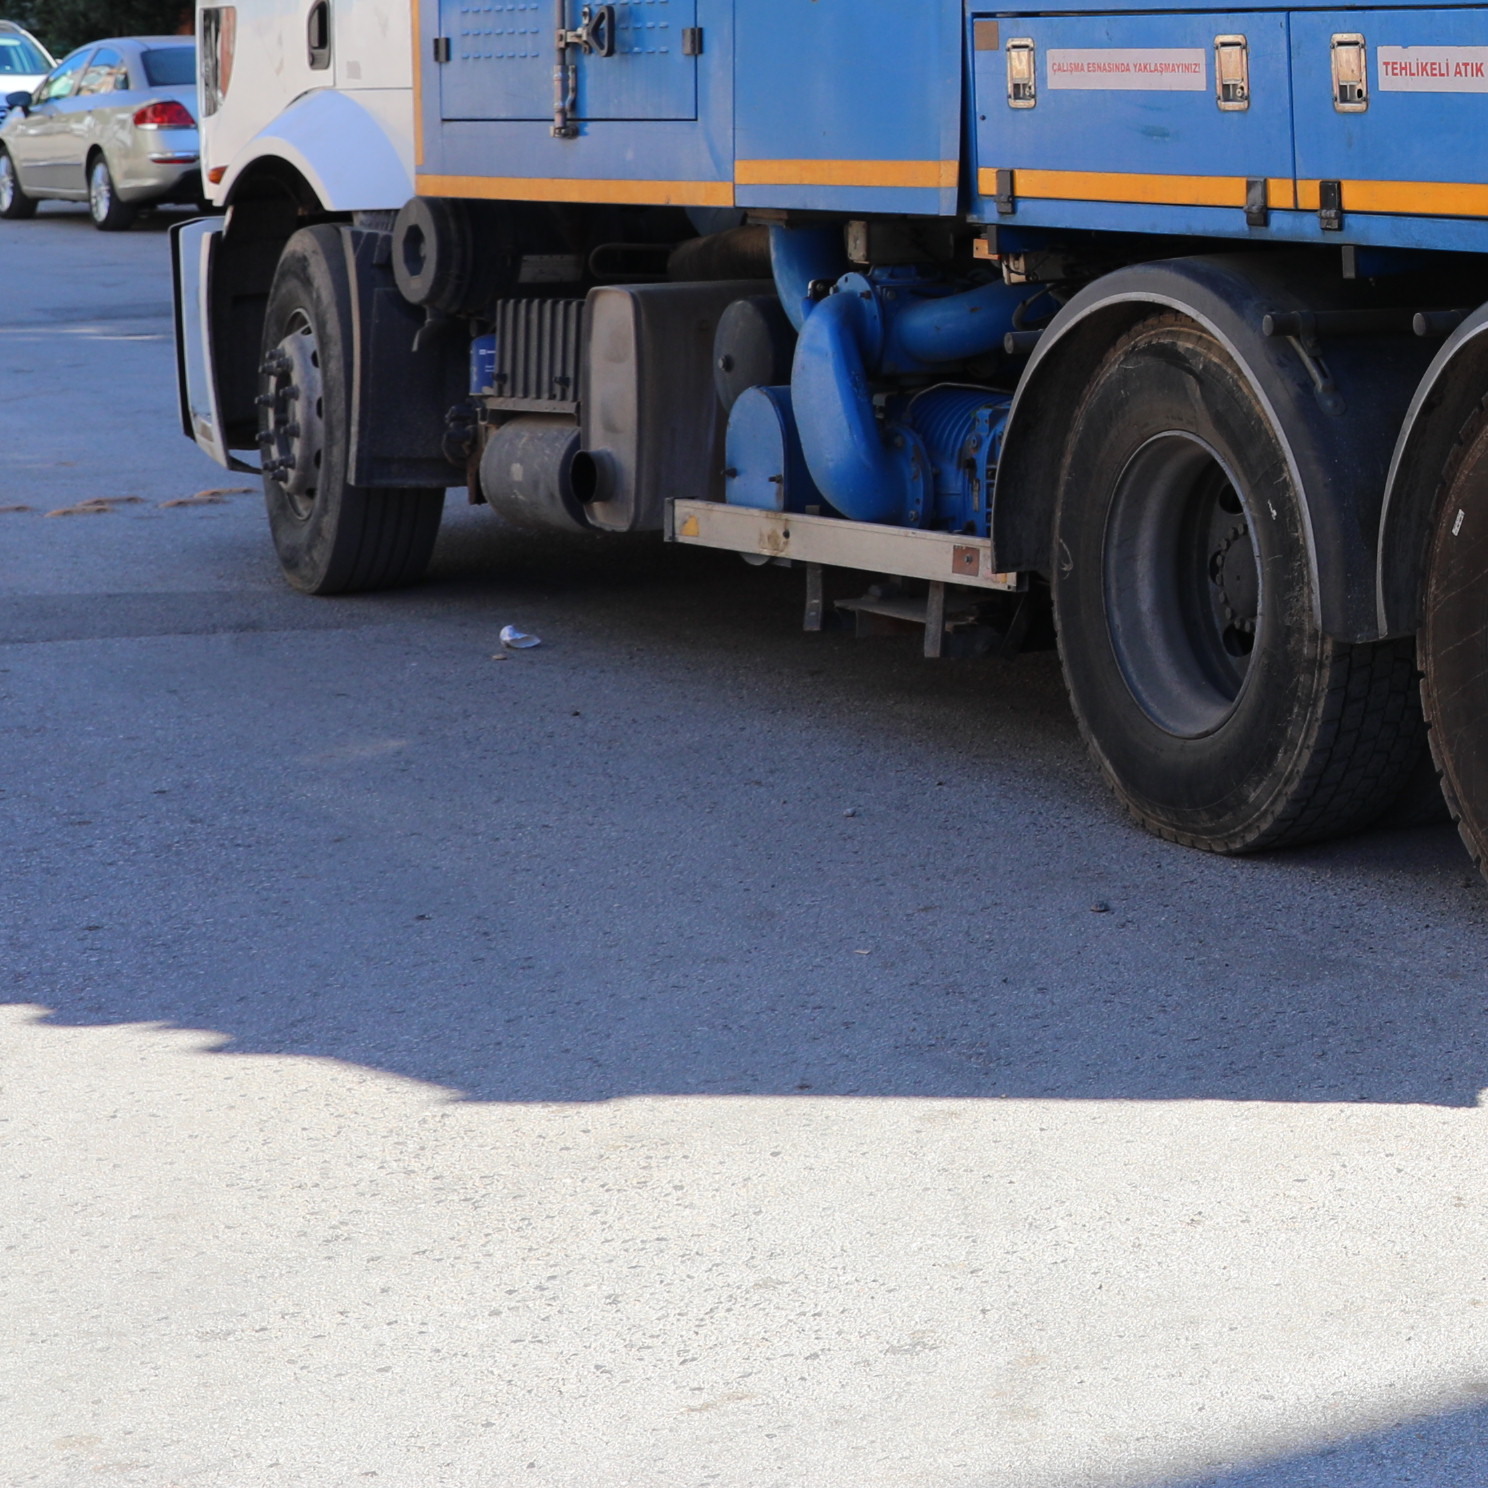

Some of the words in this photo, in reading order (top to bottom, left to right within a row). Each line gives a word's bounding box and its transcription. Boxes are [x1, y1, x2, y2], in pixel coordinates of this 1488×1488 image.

[1051, 62, 1086, 75] ÇALIŞMA
[1087, 62, 1131, 74] ESNASINDA
[1383, 58, 1450, 78] TEHLİKELİ
[1454, 62, 1485, 78] ATIK
